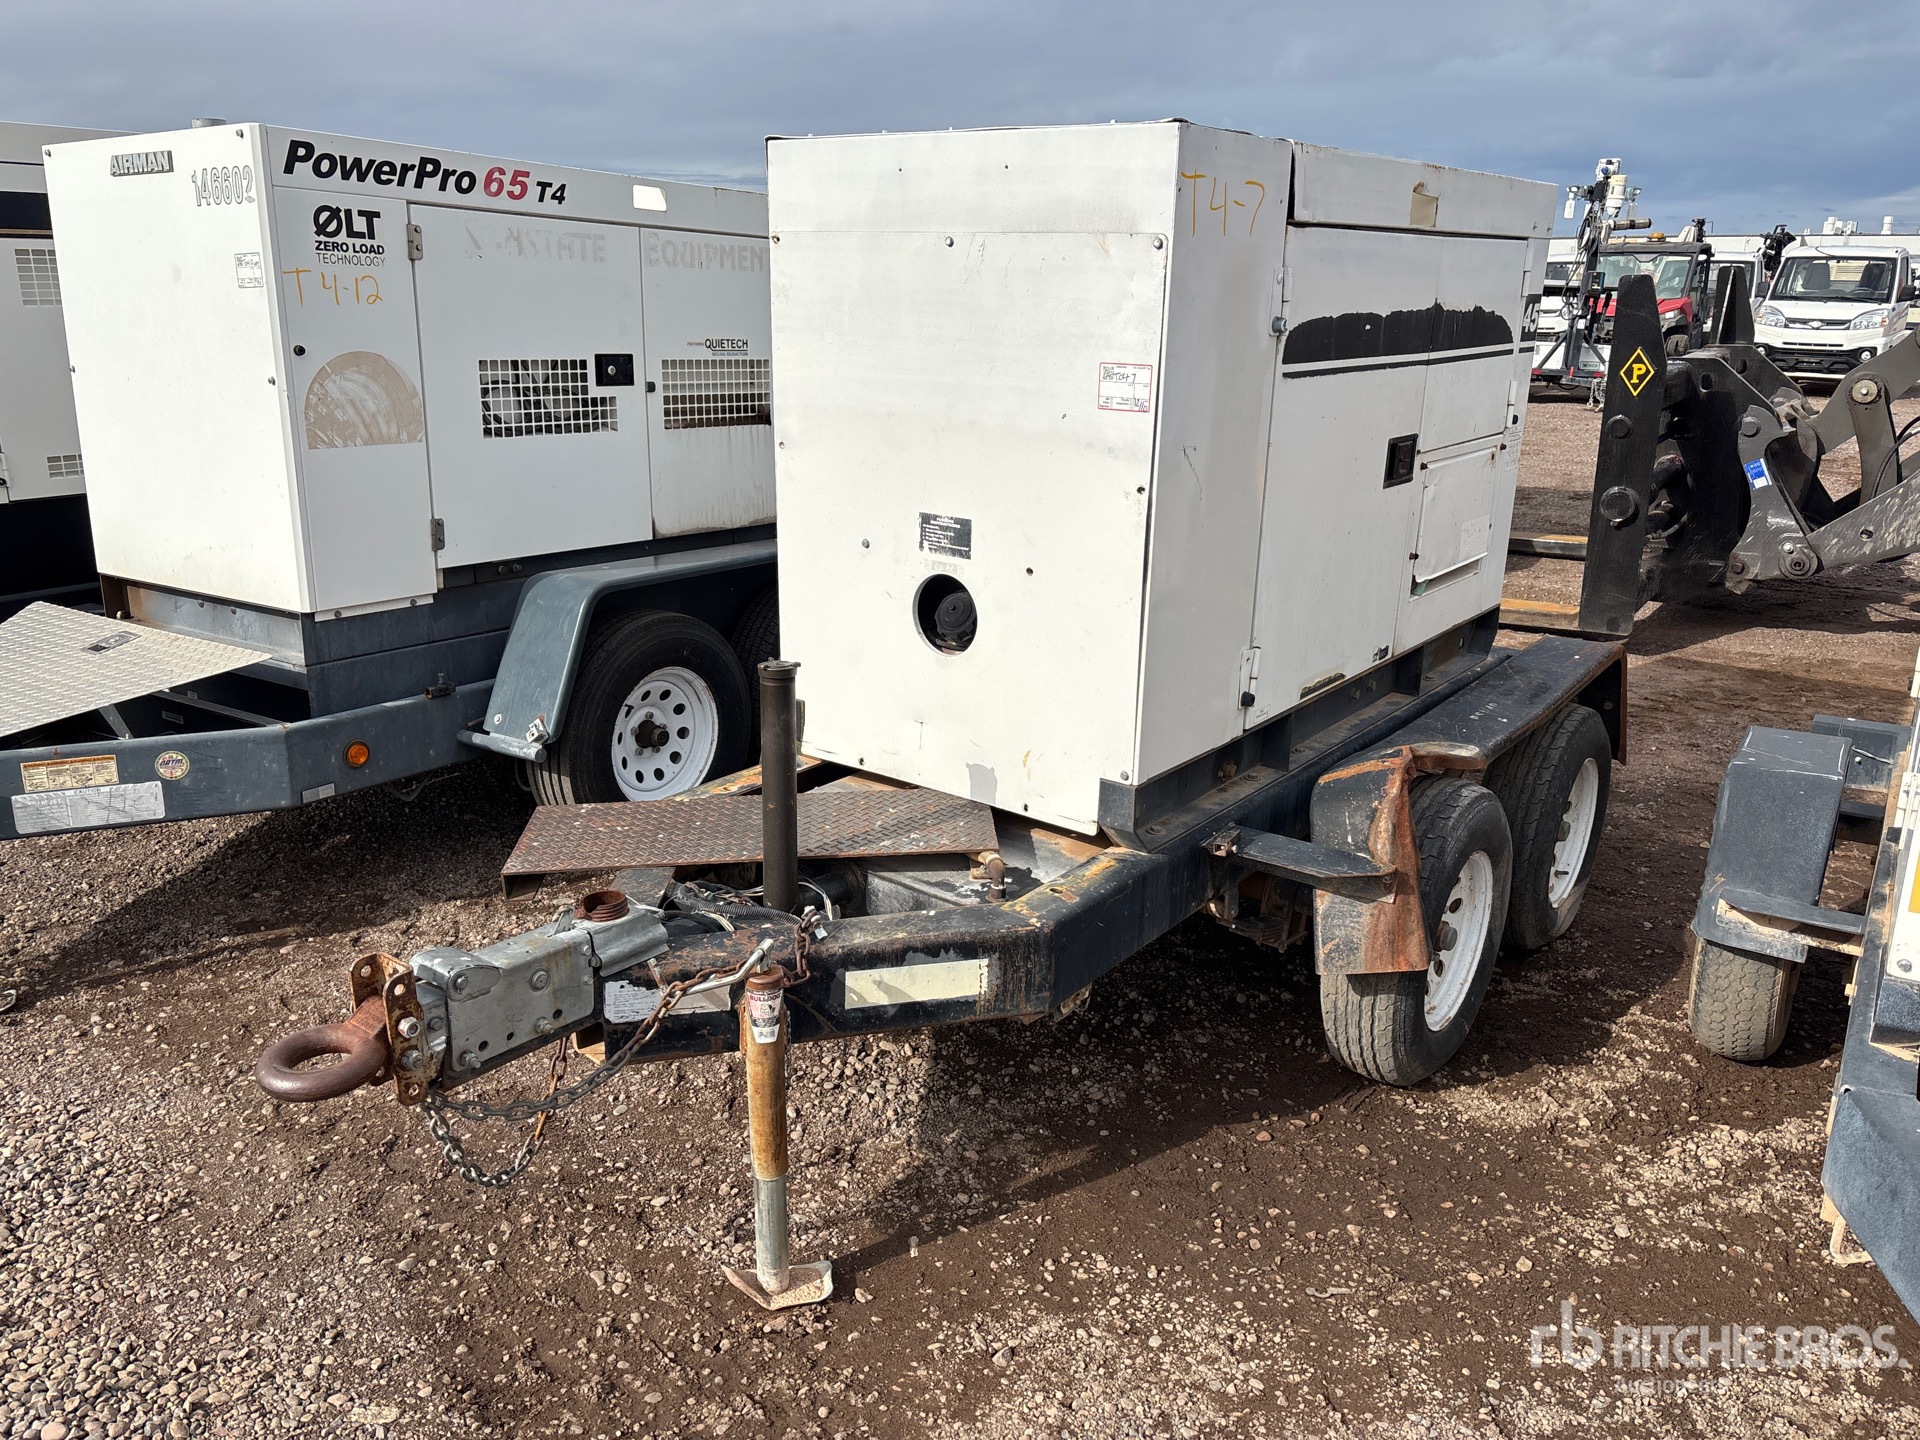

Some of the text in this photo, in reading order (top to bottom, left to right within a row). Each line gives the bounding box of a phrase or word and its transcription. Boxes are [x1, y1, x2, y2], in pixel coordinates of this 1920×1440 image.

[110, 151, 173, 177] AIRMAN
[283, 139, 567, 205] PowerPro 65 T4
[315, 240, 385, 255] ZERO LOAD
[316, 253, 386, 267] TECHNOLOGY
[1522, 303, 1540, 333] 45
[705, 338, 749, 350] QUIETECH
[1630, 363, 1647, 384] P
